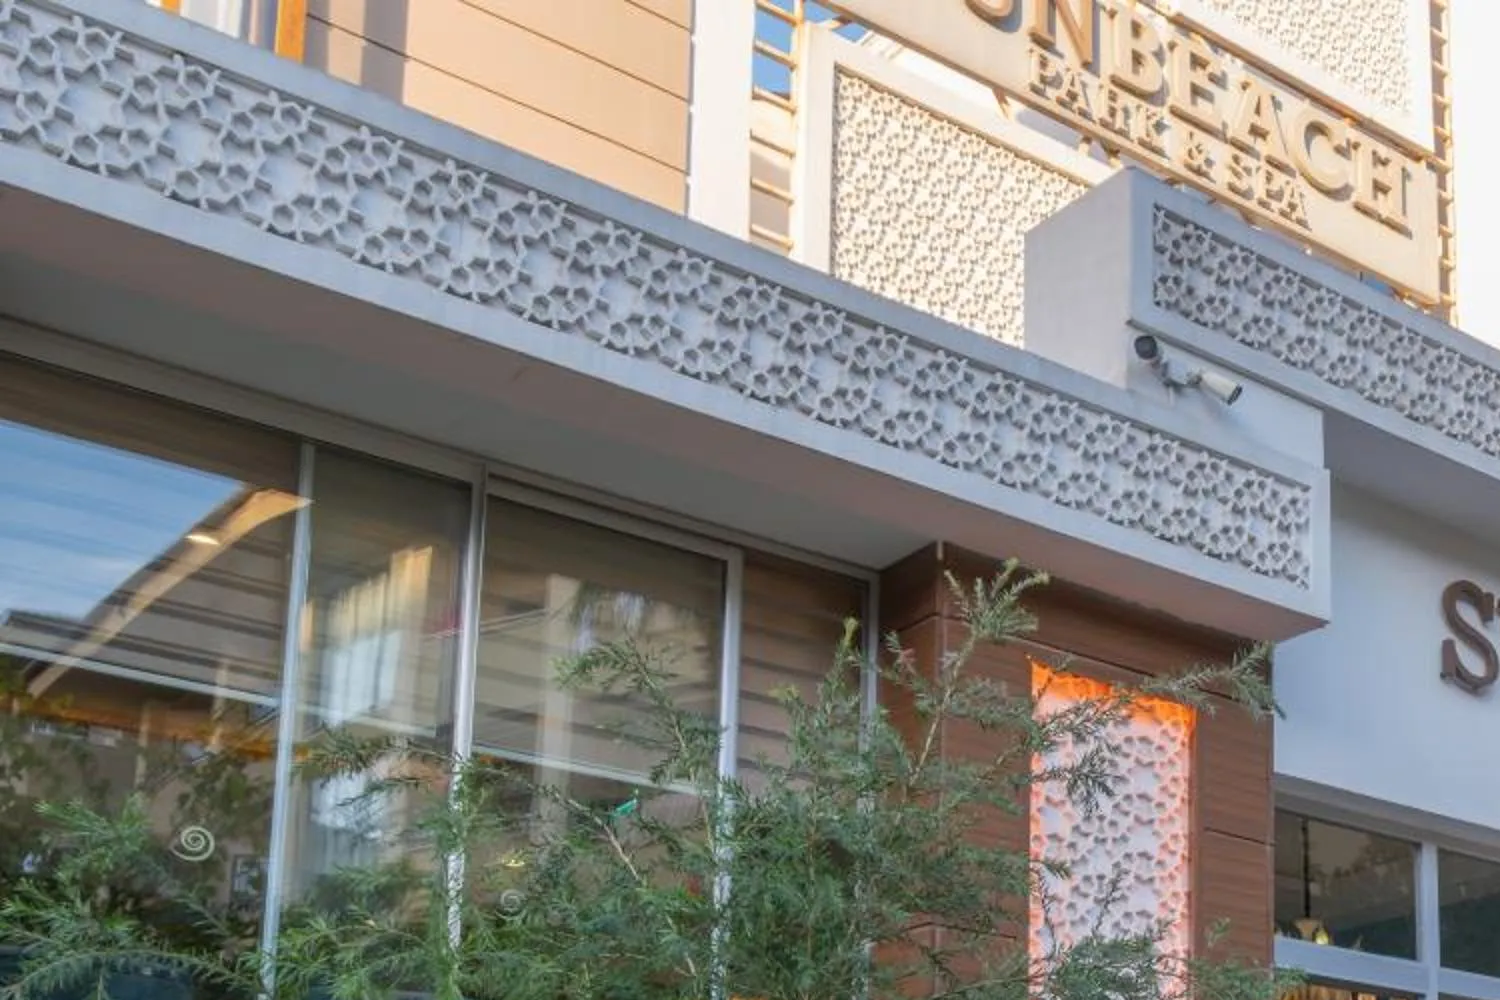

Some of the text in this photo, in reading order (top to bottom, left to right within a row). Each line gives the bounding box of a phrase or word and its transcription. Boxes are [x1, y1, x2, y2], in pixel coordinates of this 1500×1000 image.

[1027, 46, 1313, 231] PARK & SPA
